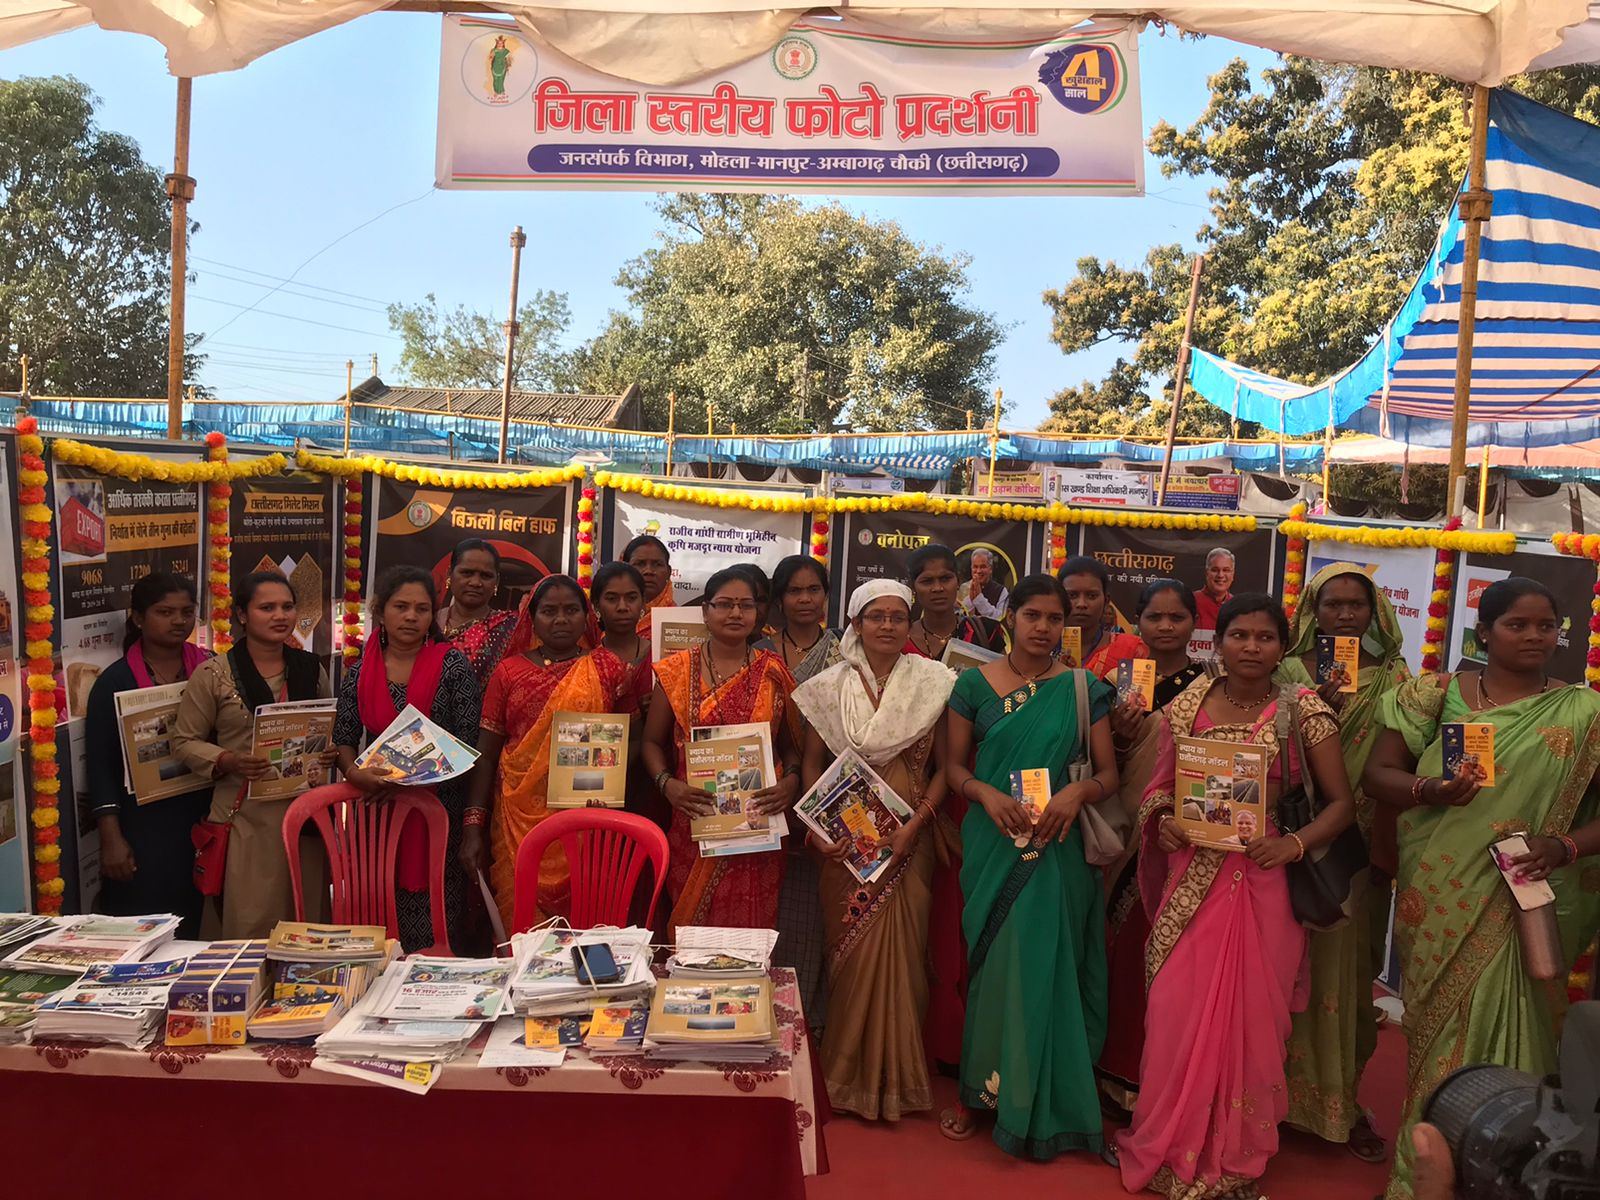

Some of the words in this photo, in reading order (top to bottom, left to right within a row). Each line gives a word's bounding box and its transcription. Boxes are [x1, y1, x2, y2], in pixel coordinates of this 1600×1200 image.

[1061, 50, 1106, 101] 4
[1065, 88, 1086, 98] साल
[534, 77, 638, 133] जिला
[646, 82, 775, 136] स्तरीय
[786, 84, 884, 137] फोटो
[896, 86, 1040, 140] प्रदर्शनी
[559, 150, 629, 166] जनसंपर्क
[635, 150, 694, 170] विभाग,
[700, 152, 885, 172] मोहला-मानपुर-अम्बागढ़
[891, 153, 931, 170] चौकी
[937, 153, 1028, 172] (छत्तीसगढ़)
[1049, 481, 1069, 493] विास
[1101, 484, 1127, 495] अधिकारी
[107, 489, 132, 508] आर्थिक
[132, 489, 154, 507] तरक्की
[154, 492, 171, 507] करता
[172, 489, 197, 508] छत्तीसगढ़
[251, 496, 283, 511] छत्तीसगढ़
[284, 496, 301, 511] मिलेट
[302, 496, 320, 511] मिशन
[77, 510, 101, 540] EXPORT
[451, 507, 496, 531] बिजली
[499, 510, 527, 532] बिल
[529, 517, 557, 534] हाफ
[110, 523, 129, 540] निर्यात
[148, 522, 160, 537] तीन
[160, 525, 171, 540] गुना
[172, 520, 179, 535] की
[669, 526, 693, 537] राजीव
[694, 526, 715, 538] गांधी
[717, 528, 743, 540] ग्रामीण
[745, 529, 777, 544] भूमिहीन
[667, 539, 686, 552] कृषि
[687, 541, 711, 554] मजदूर
[713, 545, 733, 554] न्याय
[734, 542, 761, 555] योजना
[1094, 548, 1176, 573] छत्तीसगढ़
[81, 569, 102, 586] 9068
[1117, 572, 1128, 582] की
[1129, 573, 1143, 583] नयी
[1393, 587, 1409, 600] गांधी
[1398, 603, 1420, 618] योजना
[705, 747, 714, 755] का
[1197, 746, 1206, 754] का
